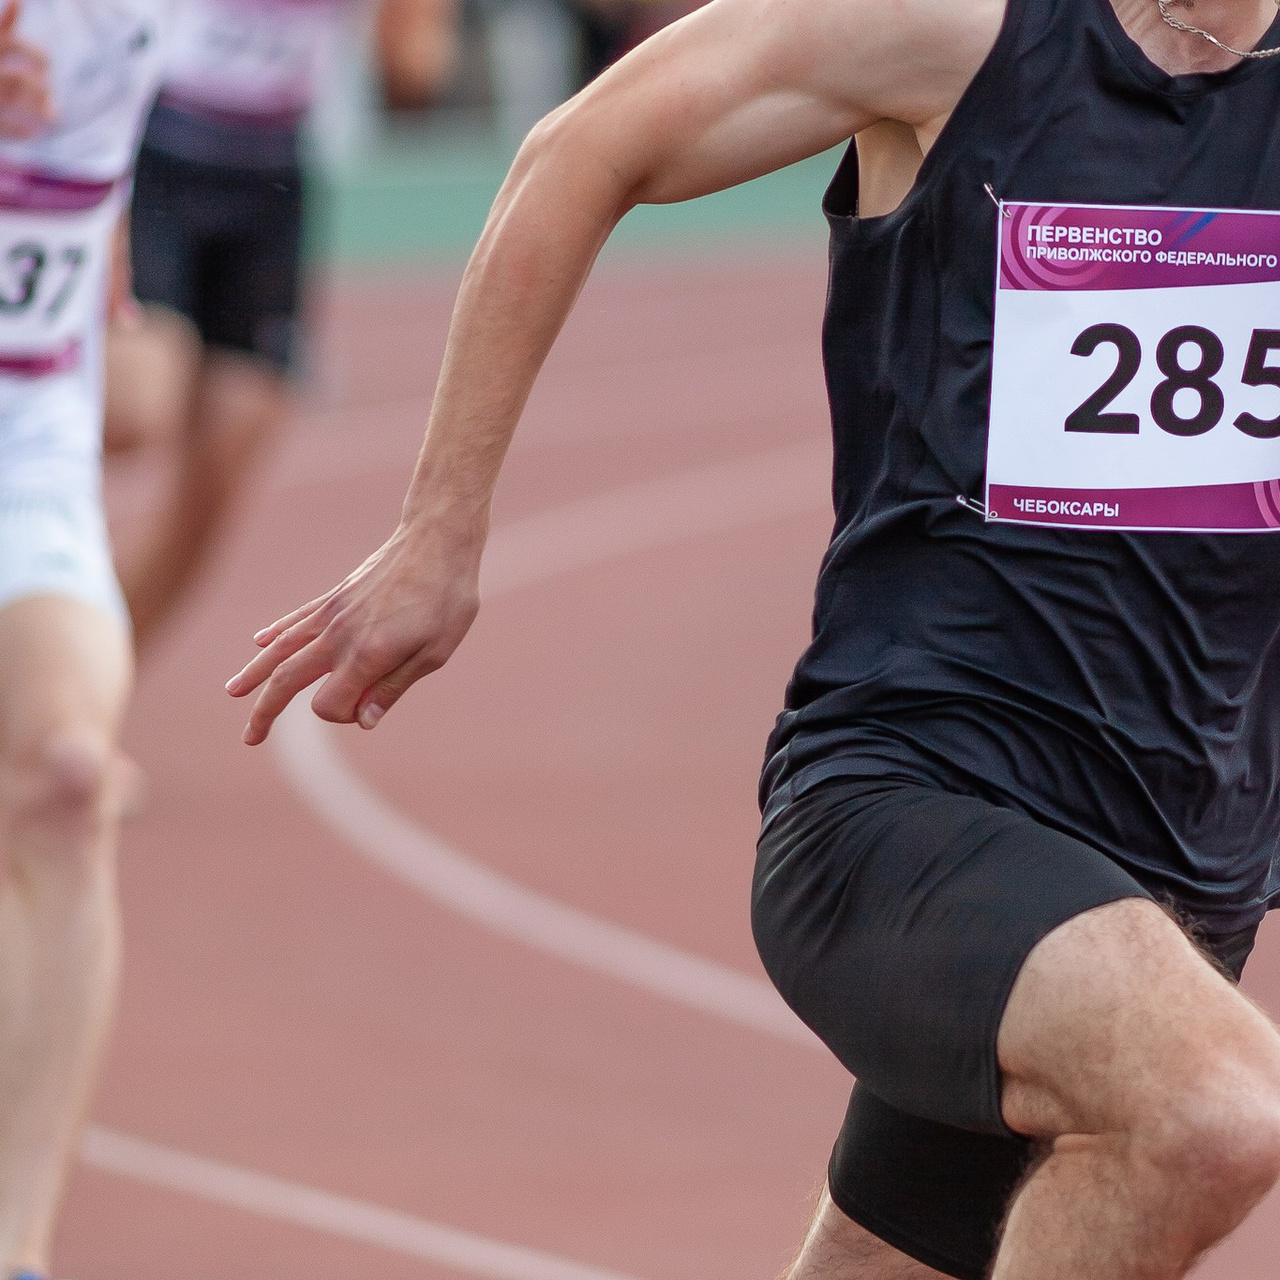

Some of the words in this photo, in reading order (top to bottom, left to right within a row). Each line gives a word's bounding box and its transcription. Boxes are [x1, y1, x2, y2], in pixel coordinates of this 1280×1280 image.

[1027, 225, 1162, 246] ПЕРВЕНСТВО
[1026, 246, 1152, 264] ПРИВОЛЖСКОГО
[1155, 250, 1278, 268] ФЕДЕРАЛЬНОГО
[1013, 498, 1119, 517] ЧЕБОКСАРЫ
